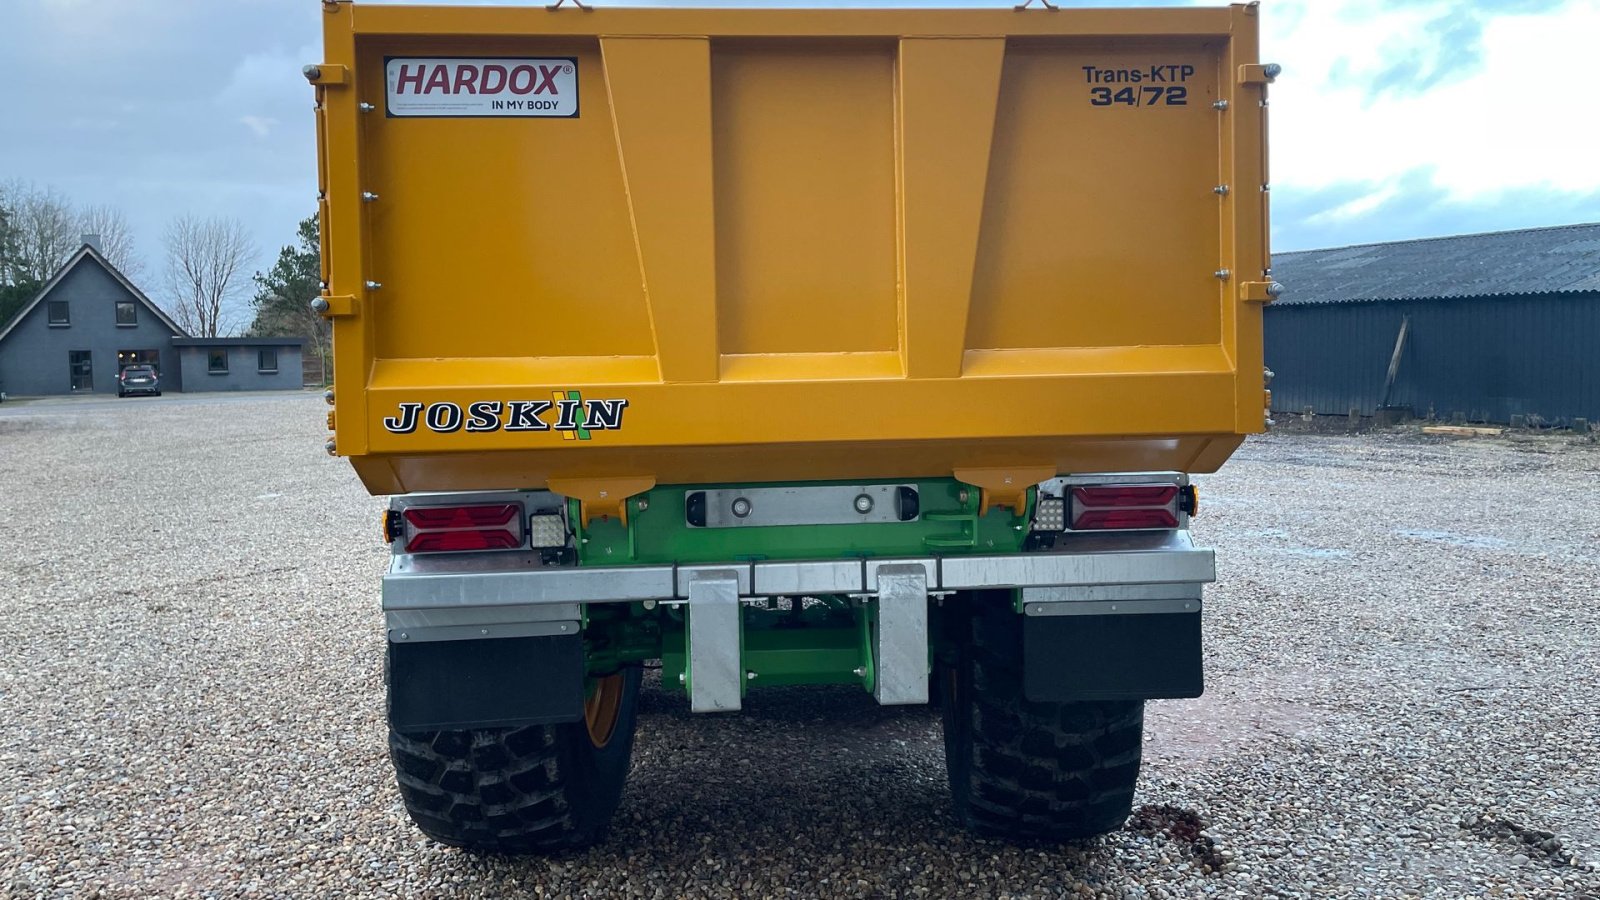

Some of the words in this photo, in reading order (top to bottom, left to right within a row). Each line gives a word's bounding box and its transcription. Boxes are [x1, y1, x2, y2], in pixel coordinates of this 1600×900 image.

[1082, 65, 1194, 83] Trans-KTP
[492, 101, 505, 110] IN
[507, 101, 525, 110] MY
[527, 101, 559, 110] BODY
[1091, 86, 1187, 106] 34/72
[383, 399, 629, 433] JOSKIN
